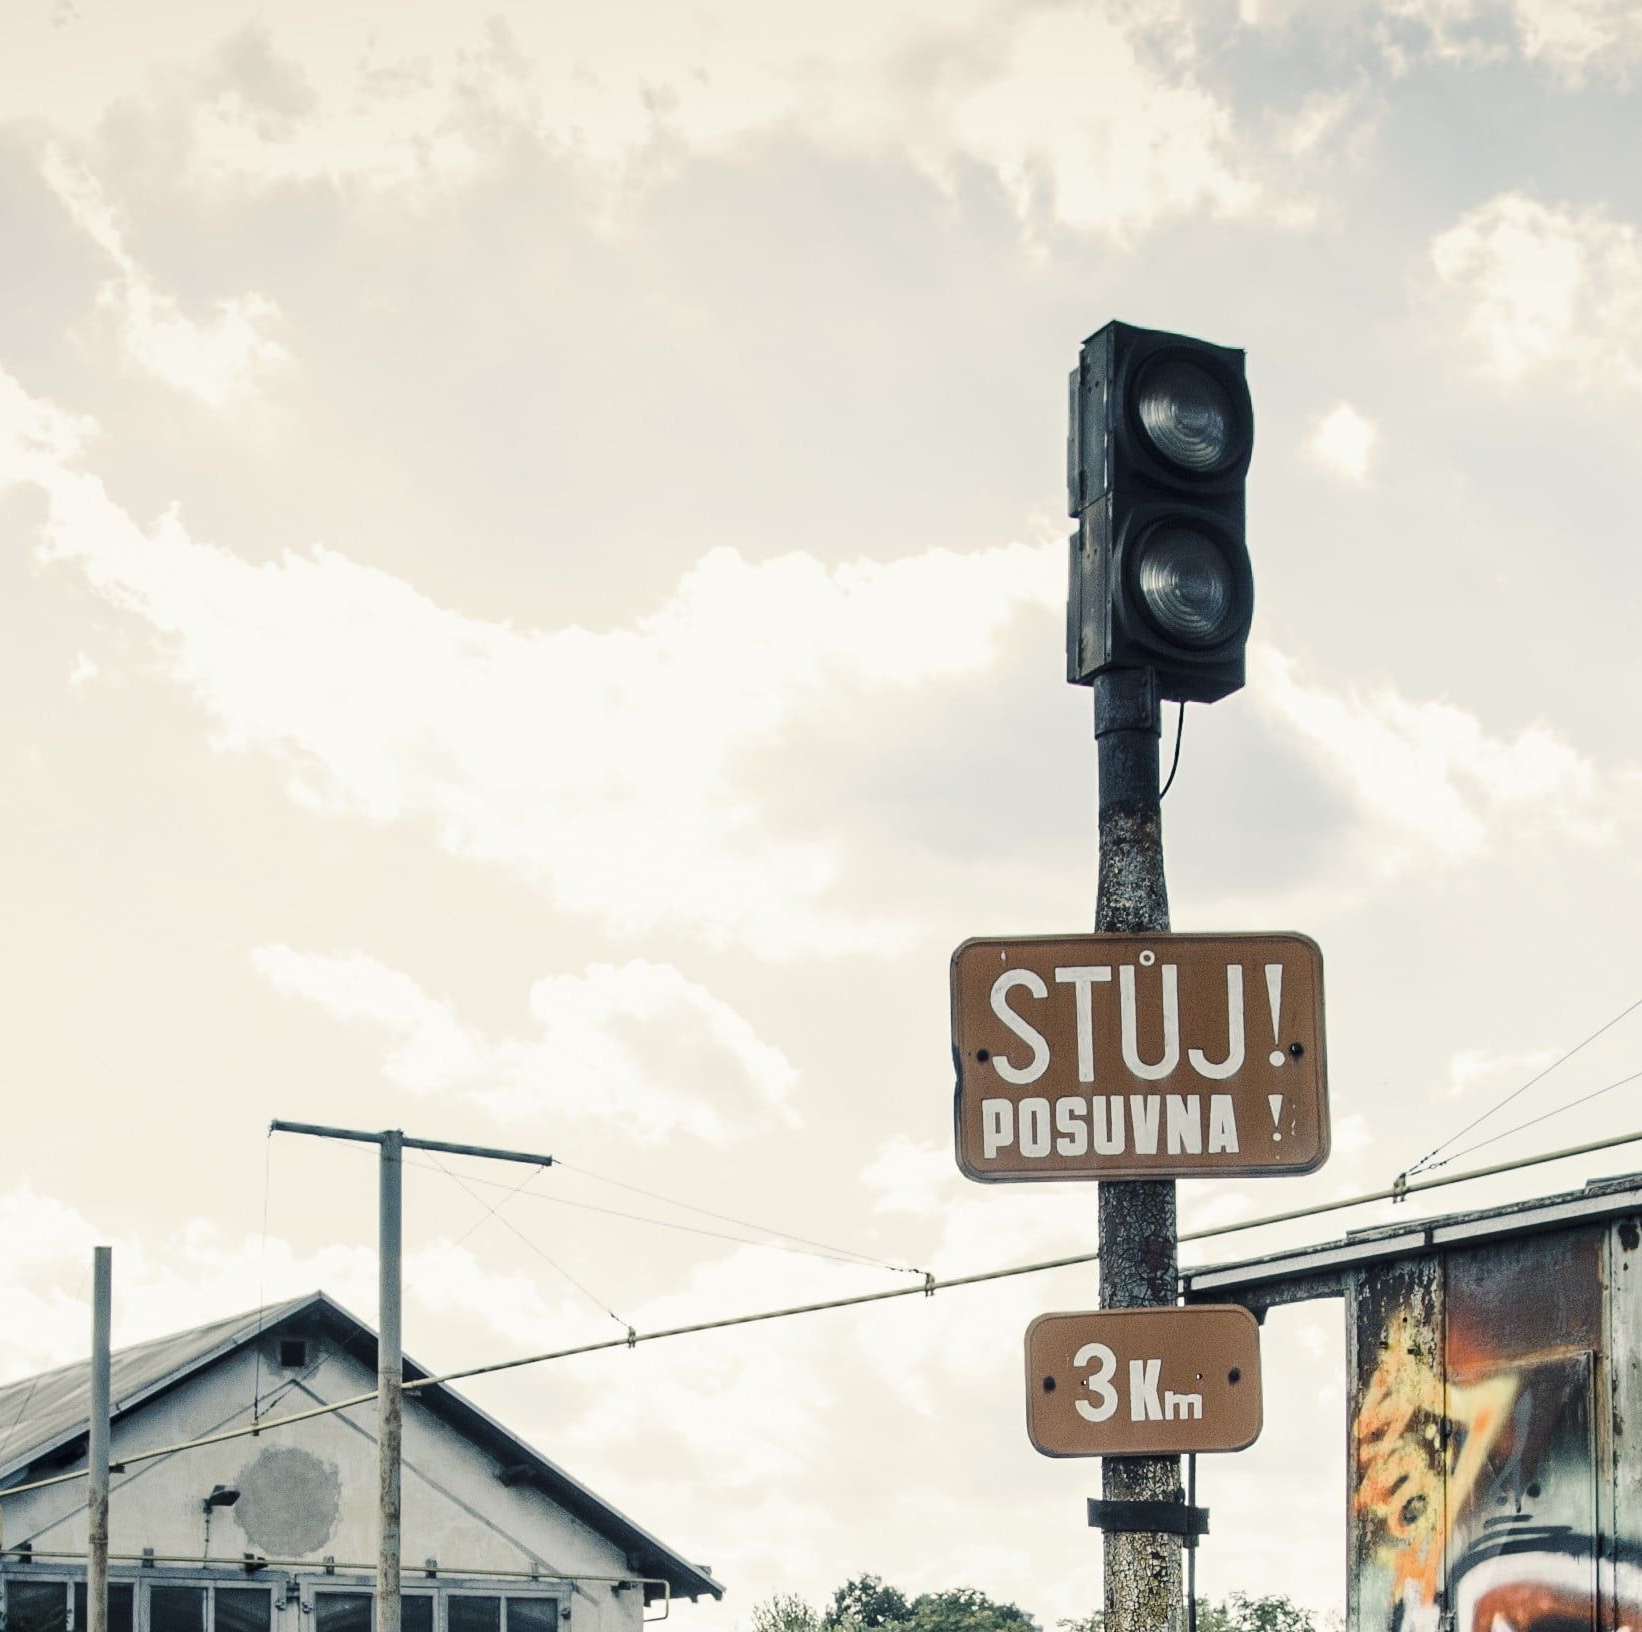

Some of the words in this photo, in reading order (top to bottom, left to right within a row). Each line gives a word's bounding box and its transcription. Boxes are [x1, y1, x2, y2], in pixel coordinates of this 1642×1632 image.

[981, 1093, 1240, 1160] POSUVNA
[1072, 1342, 1119, 1423] 3
[1128, 1358, 1203, 1422] Km
